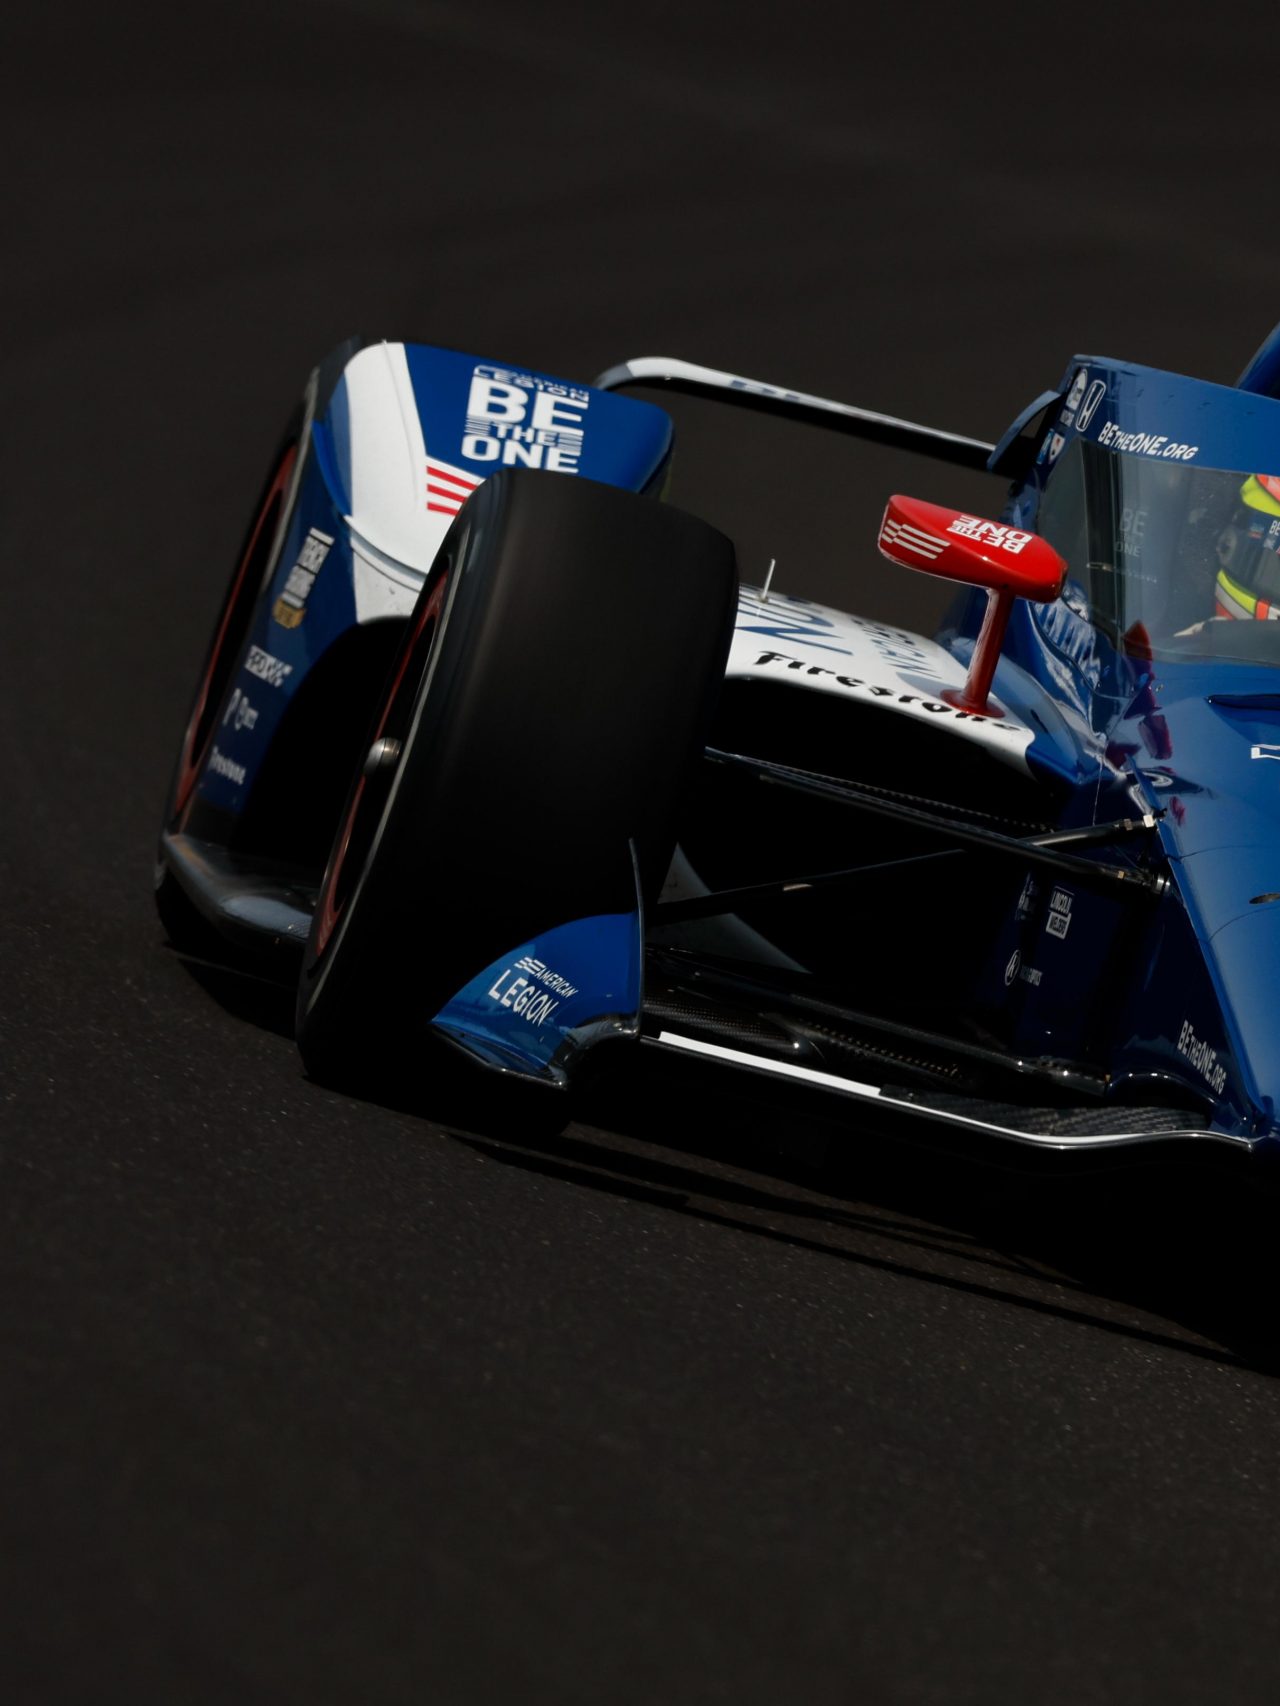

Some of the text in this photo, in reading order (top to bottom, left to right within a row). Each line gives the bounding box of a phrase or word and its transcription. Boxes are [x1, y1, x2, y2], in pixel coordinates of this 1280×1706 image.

[467, 376, 588, 436] BE
[491, 422, 557, 447] THE
[461, 434, 580, 474] ONE
[959, 515, 1032, 545] ONE
[982, 532, 1026, 554] BE
[753, 650, 1021, 731] Firestone
[488, 969, 559, 1027] LEGION
[535, 967, 579, 998] AMERICAN
